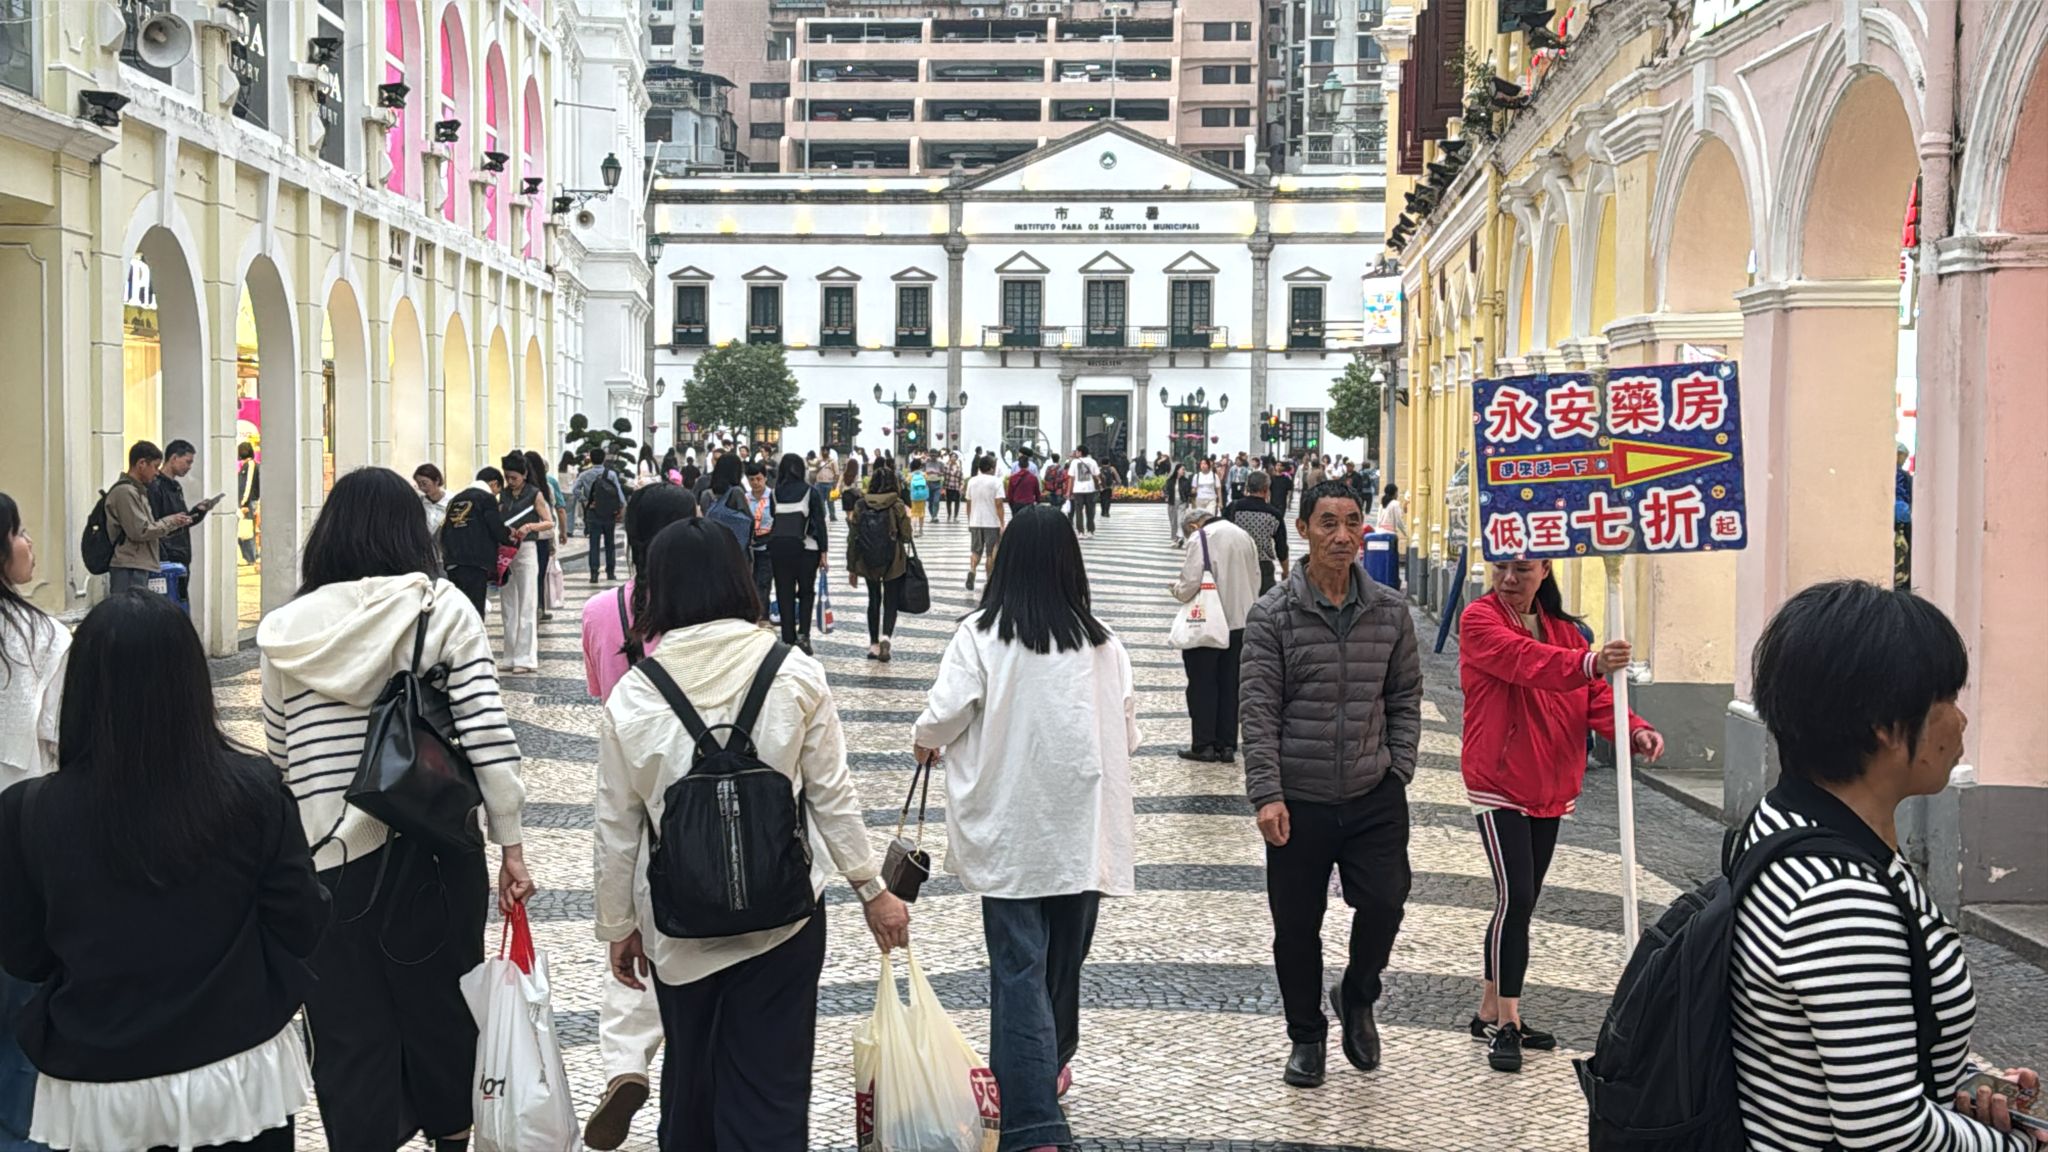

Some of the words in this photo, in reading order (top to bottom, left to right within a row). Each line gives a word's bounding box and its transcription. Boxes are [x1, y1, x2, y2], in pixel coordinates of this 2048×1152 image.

[232, 54, 260, 83] XURY
[1014, 223, 1056, 231] INSTITUTO
[1061, 223, 1082, 231] PARA
[1088, 223, 1099, 231] OS
[1104, 223, 1147, 231] ASSUNTOS
[1153, 223, 1200, 231] MUNICIPAIS
[1054, 206, 1160, 221] 市政署
[1486, 373, 1727, 441] 永安藥房
[1487, 487, 1742, 553] 低至七折起
